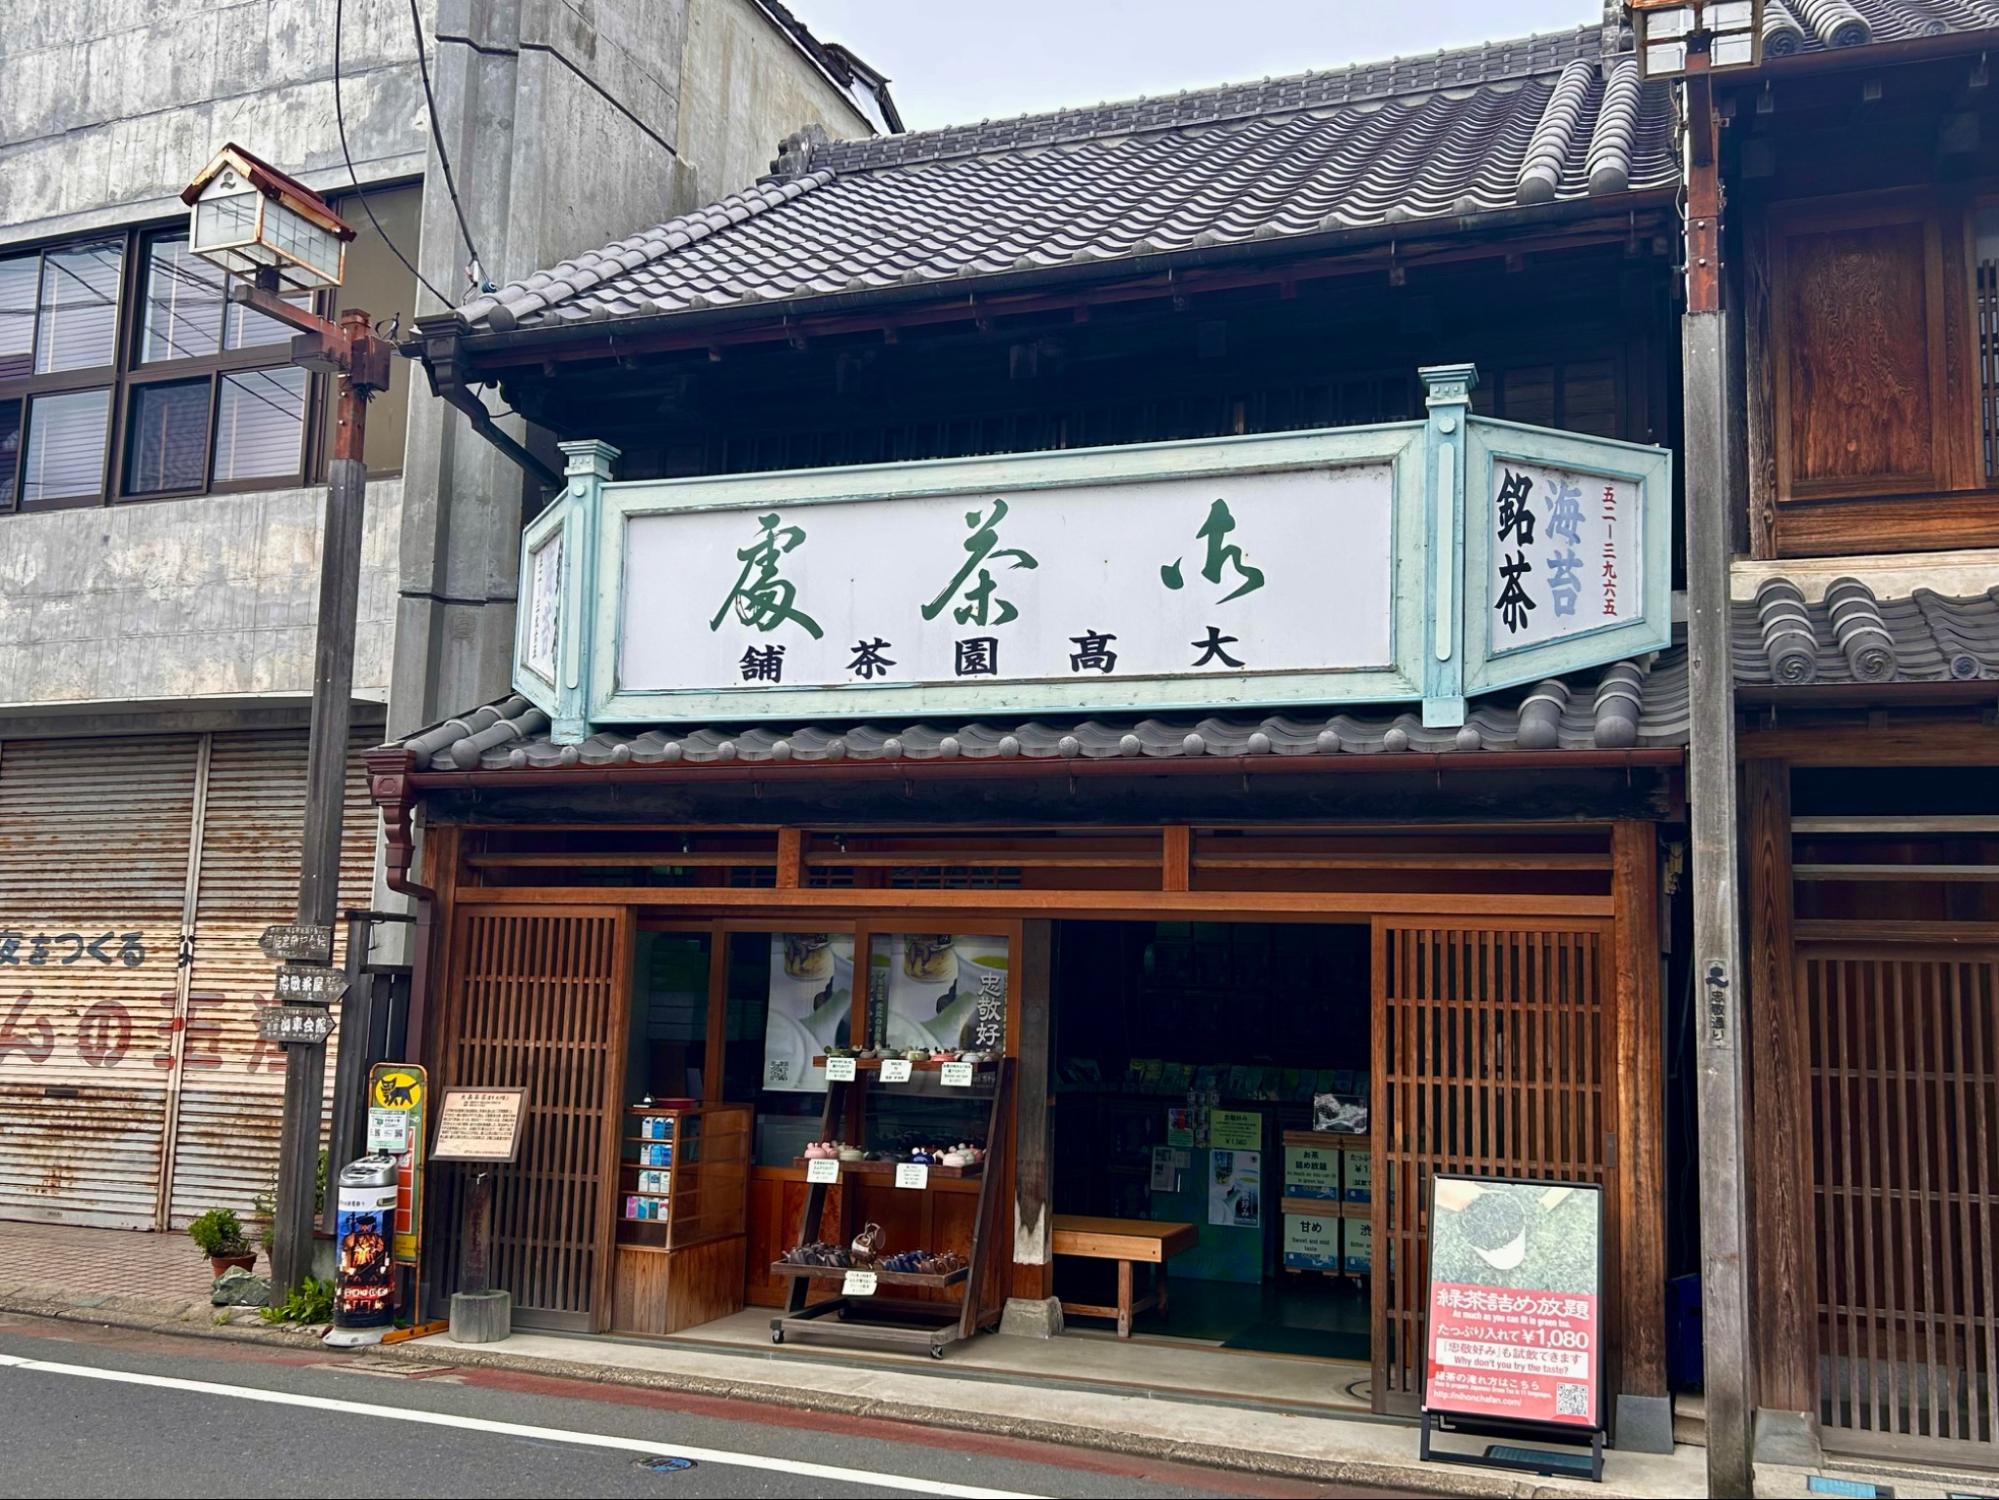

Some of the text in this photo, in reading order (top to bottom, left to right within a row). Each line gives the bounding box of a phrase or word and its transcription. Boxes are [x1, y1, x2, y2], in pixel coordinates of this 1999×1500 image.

[1494, 468, 1537, 634] 銘茶
[1545, 479, 1586, 618] 海苔
[1300, 1220, 1322, 1233] 甘め
[1436, 1288, 1589, 1320] 緑茶詰め放題
[1437, 1324, 1520, 1341] たっぷり入れて
[1454, 1355, 1569, 1375] Why don't you try the taste?
